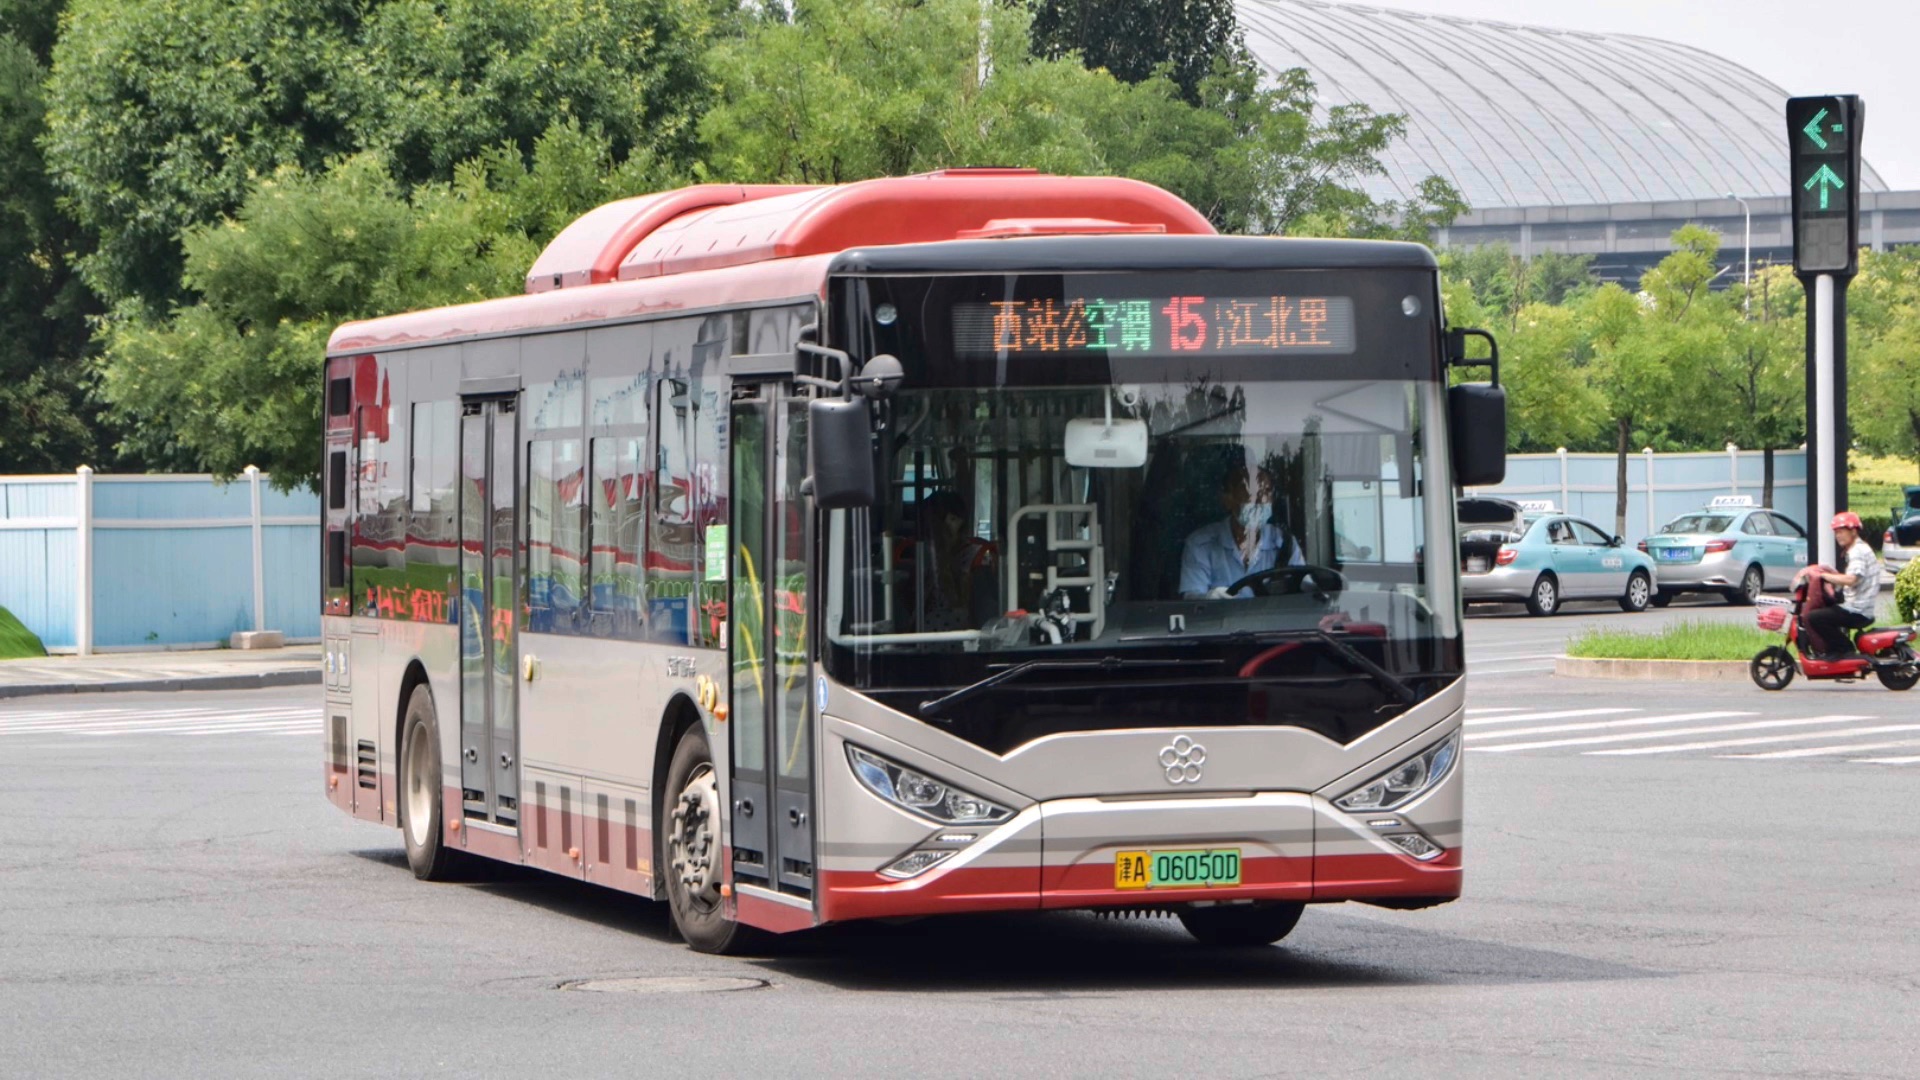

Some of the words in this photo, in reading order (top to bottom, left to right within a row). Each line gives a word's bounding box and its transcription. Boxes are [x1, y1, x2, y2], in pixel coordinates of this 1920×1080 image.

[1162, 296, 1207, 350] 15
[1216, 296, 1332, 350] 江北里
